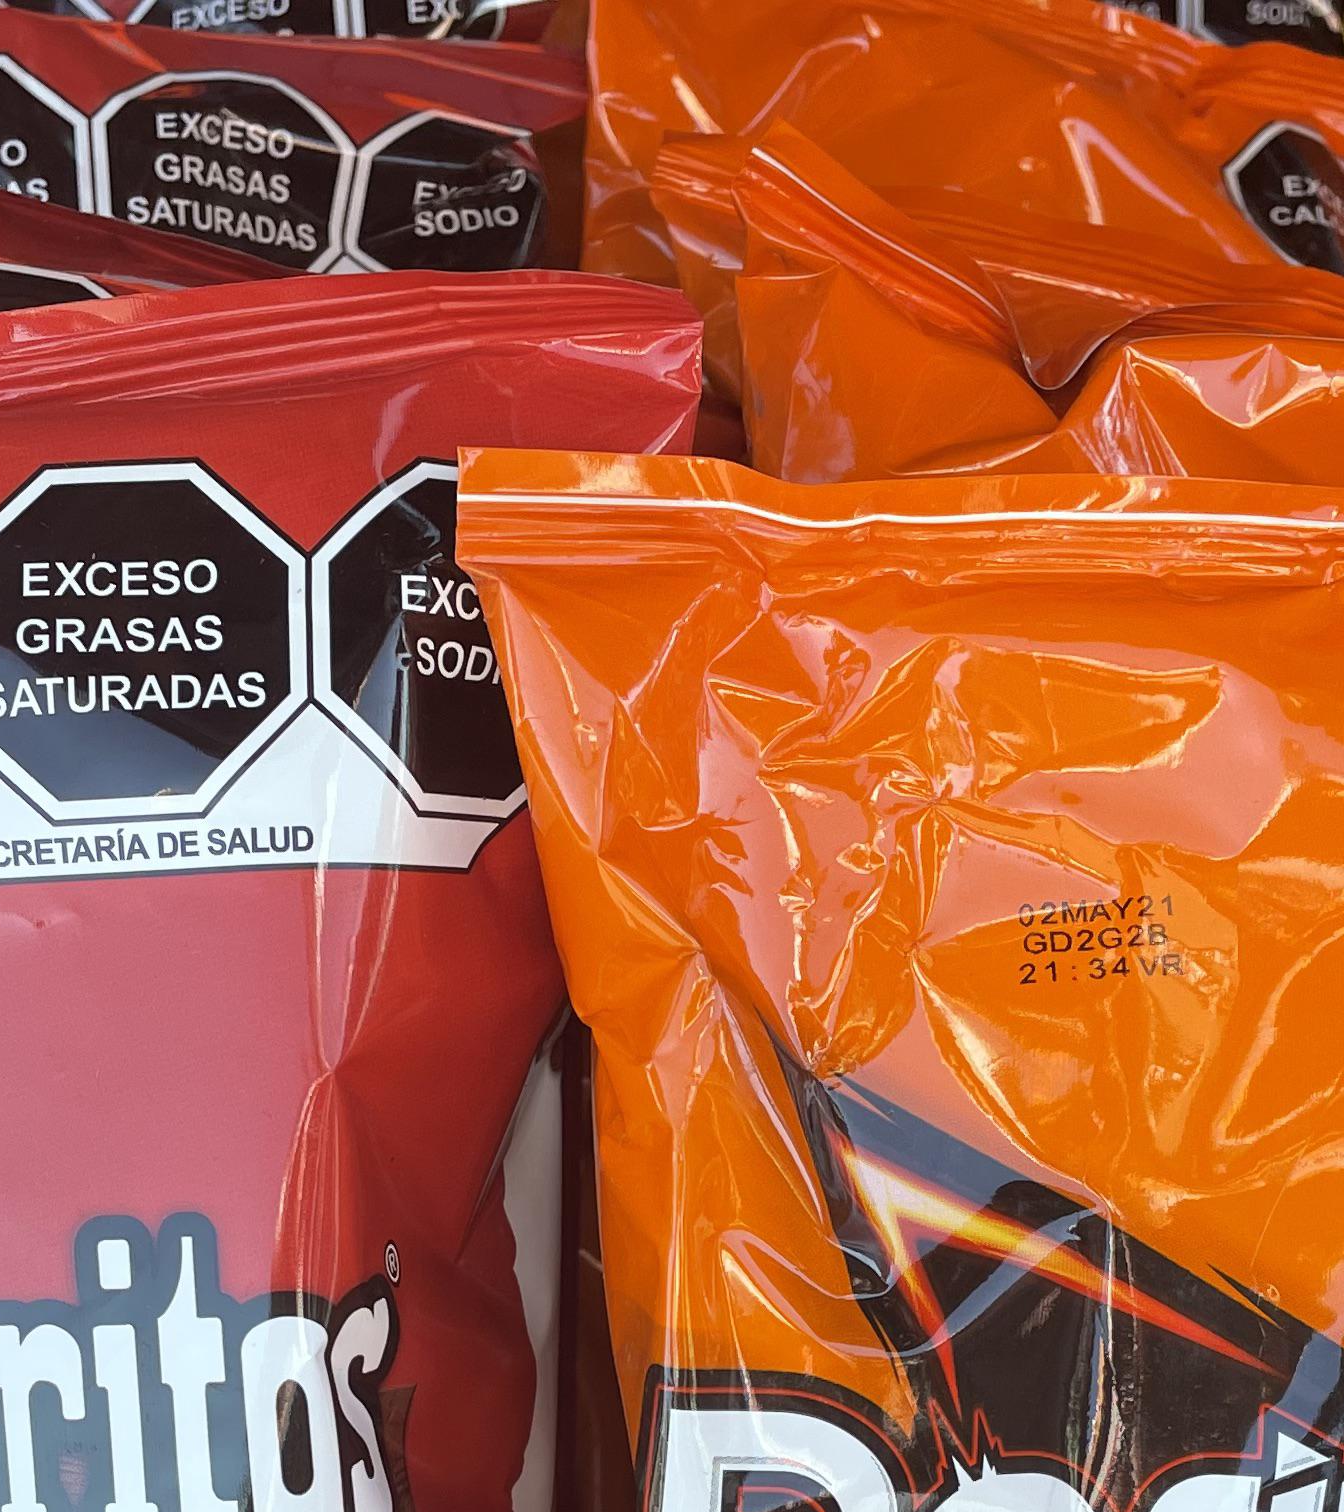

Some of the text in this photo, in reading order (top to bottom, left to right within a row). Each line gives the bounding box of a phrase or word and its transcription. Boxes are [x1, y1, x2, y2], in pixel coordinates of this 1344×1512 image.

[156, 111, 294, 160] EXCESO
[154, 152, 291, 204] GRASAS
[125, 195, 318, 253] SATURADAS
[414, 205, 519, 237] SODIO
[22, 559, 218, 597] EXCESO
[400, 573, 481, 621] EXC
[16, 614, 224, 654] GRASAS
[156, 831, 202, 860] DE
[207, 825, 314, 857] SALUD
